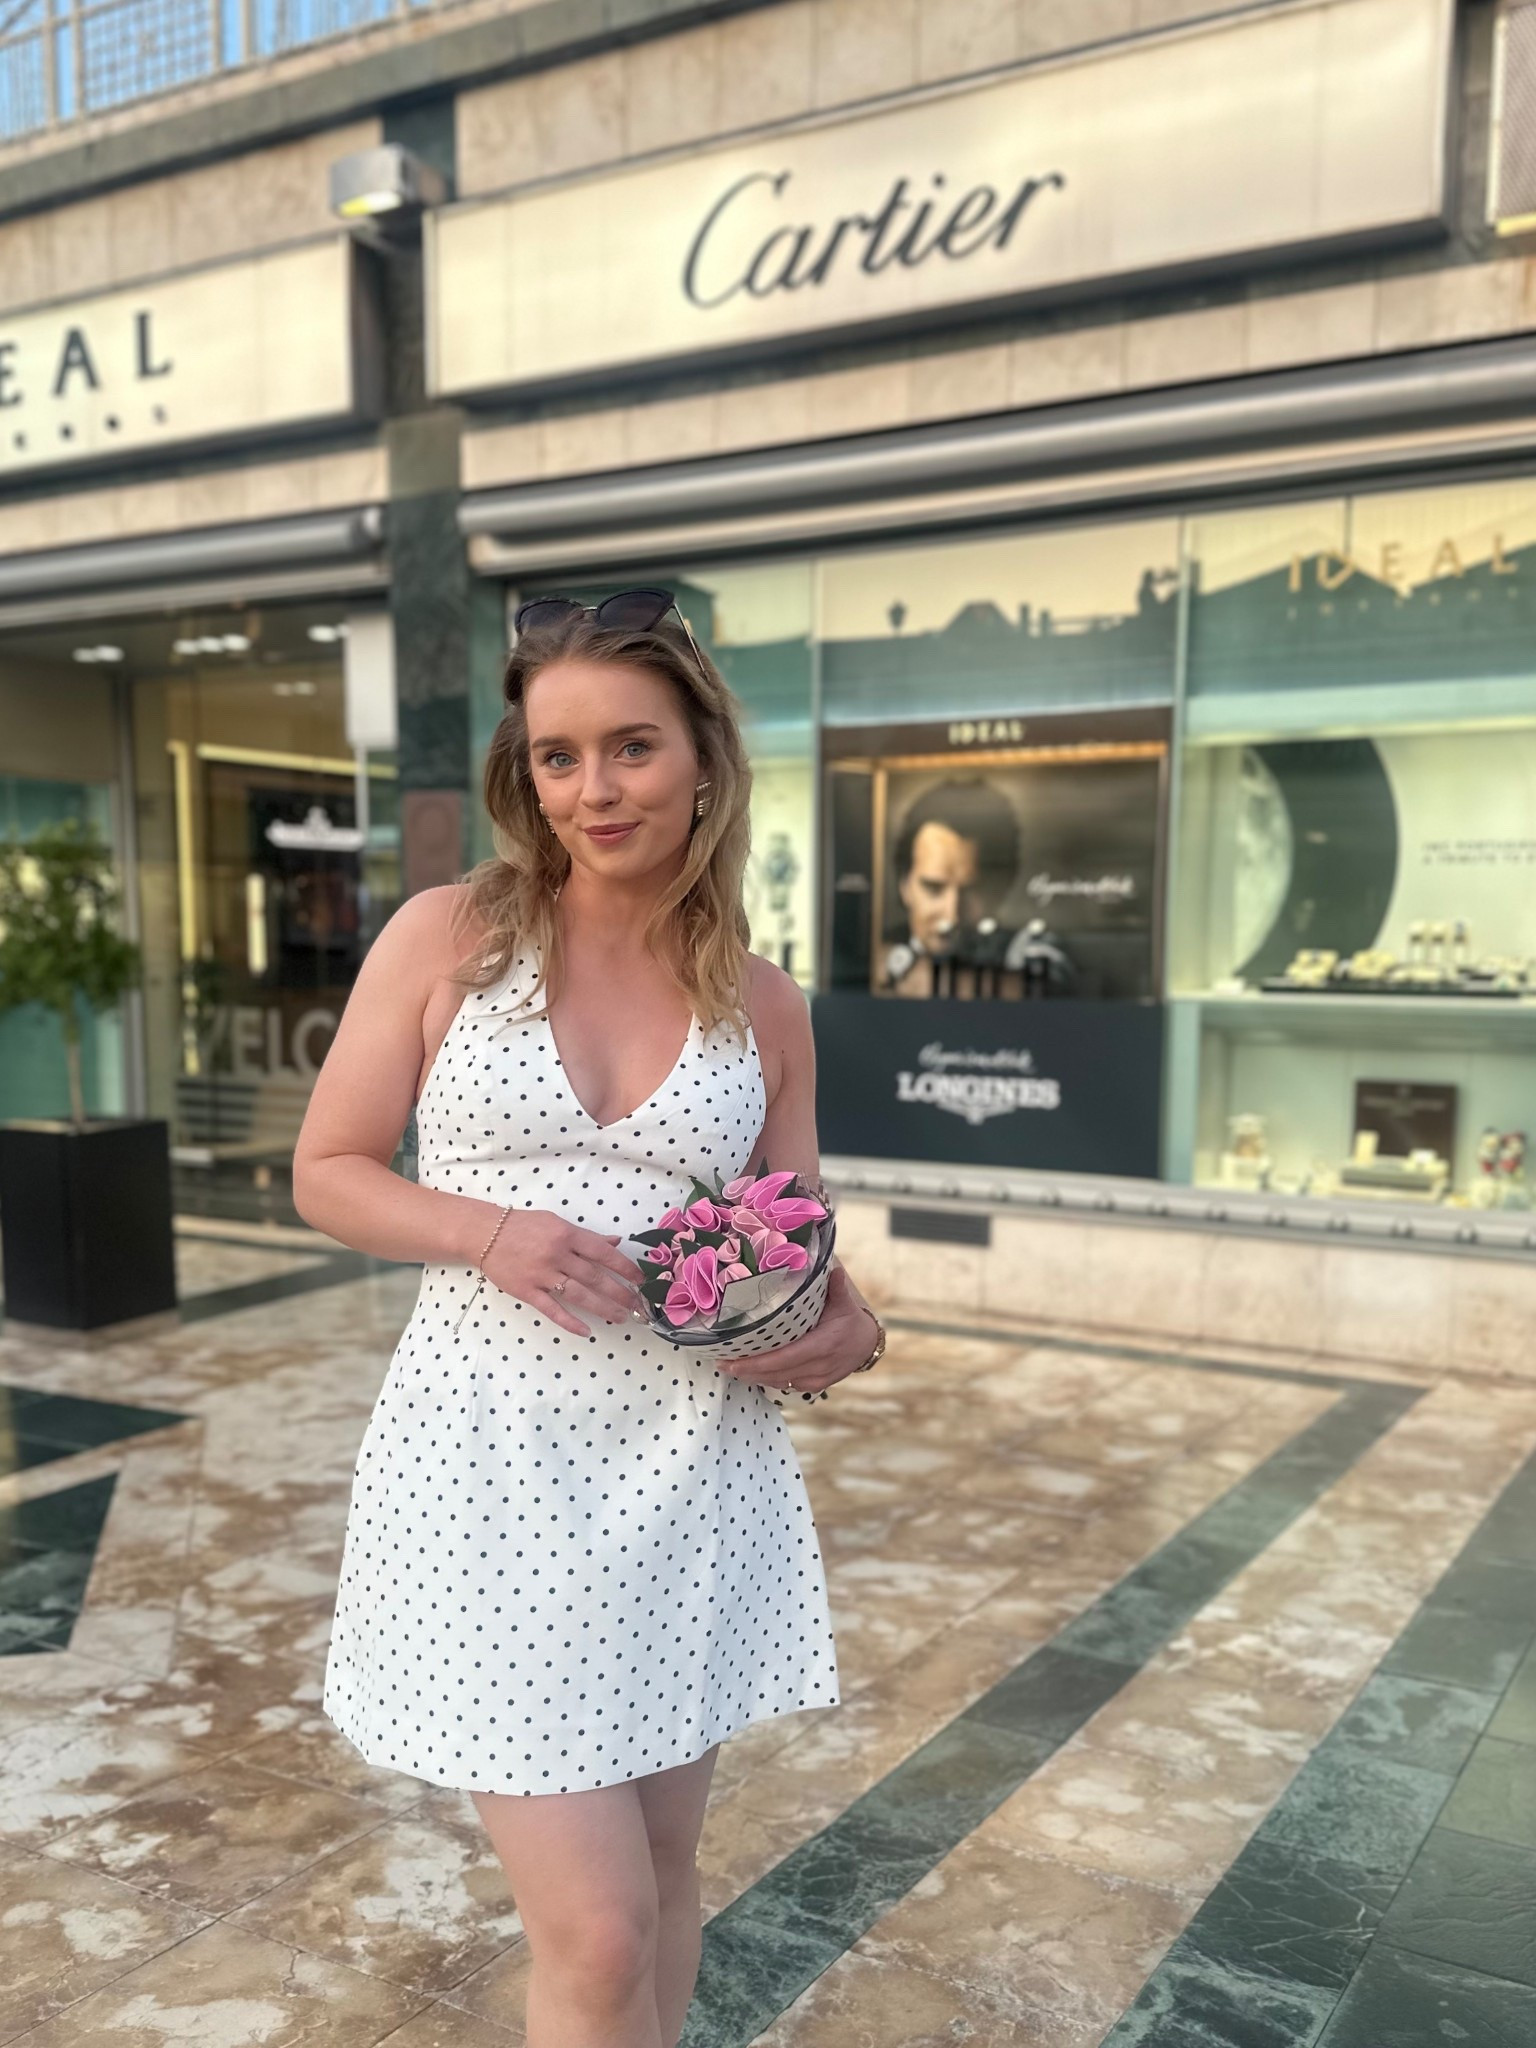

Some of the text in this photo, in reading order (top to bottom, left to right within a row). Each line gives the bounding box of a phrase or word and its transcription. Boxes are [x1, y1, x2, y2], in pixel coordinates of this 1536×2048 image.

[682, 169, 1066, 309] Cartier
[1287, 532, 1519, 593] IDEAL
[896, 1069, 1061, 1110] LONGINES
